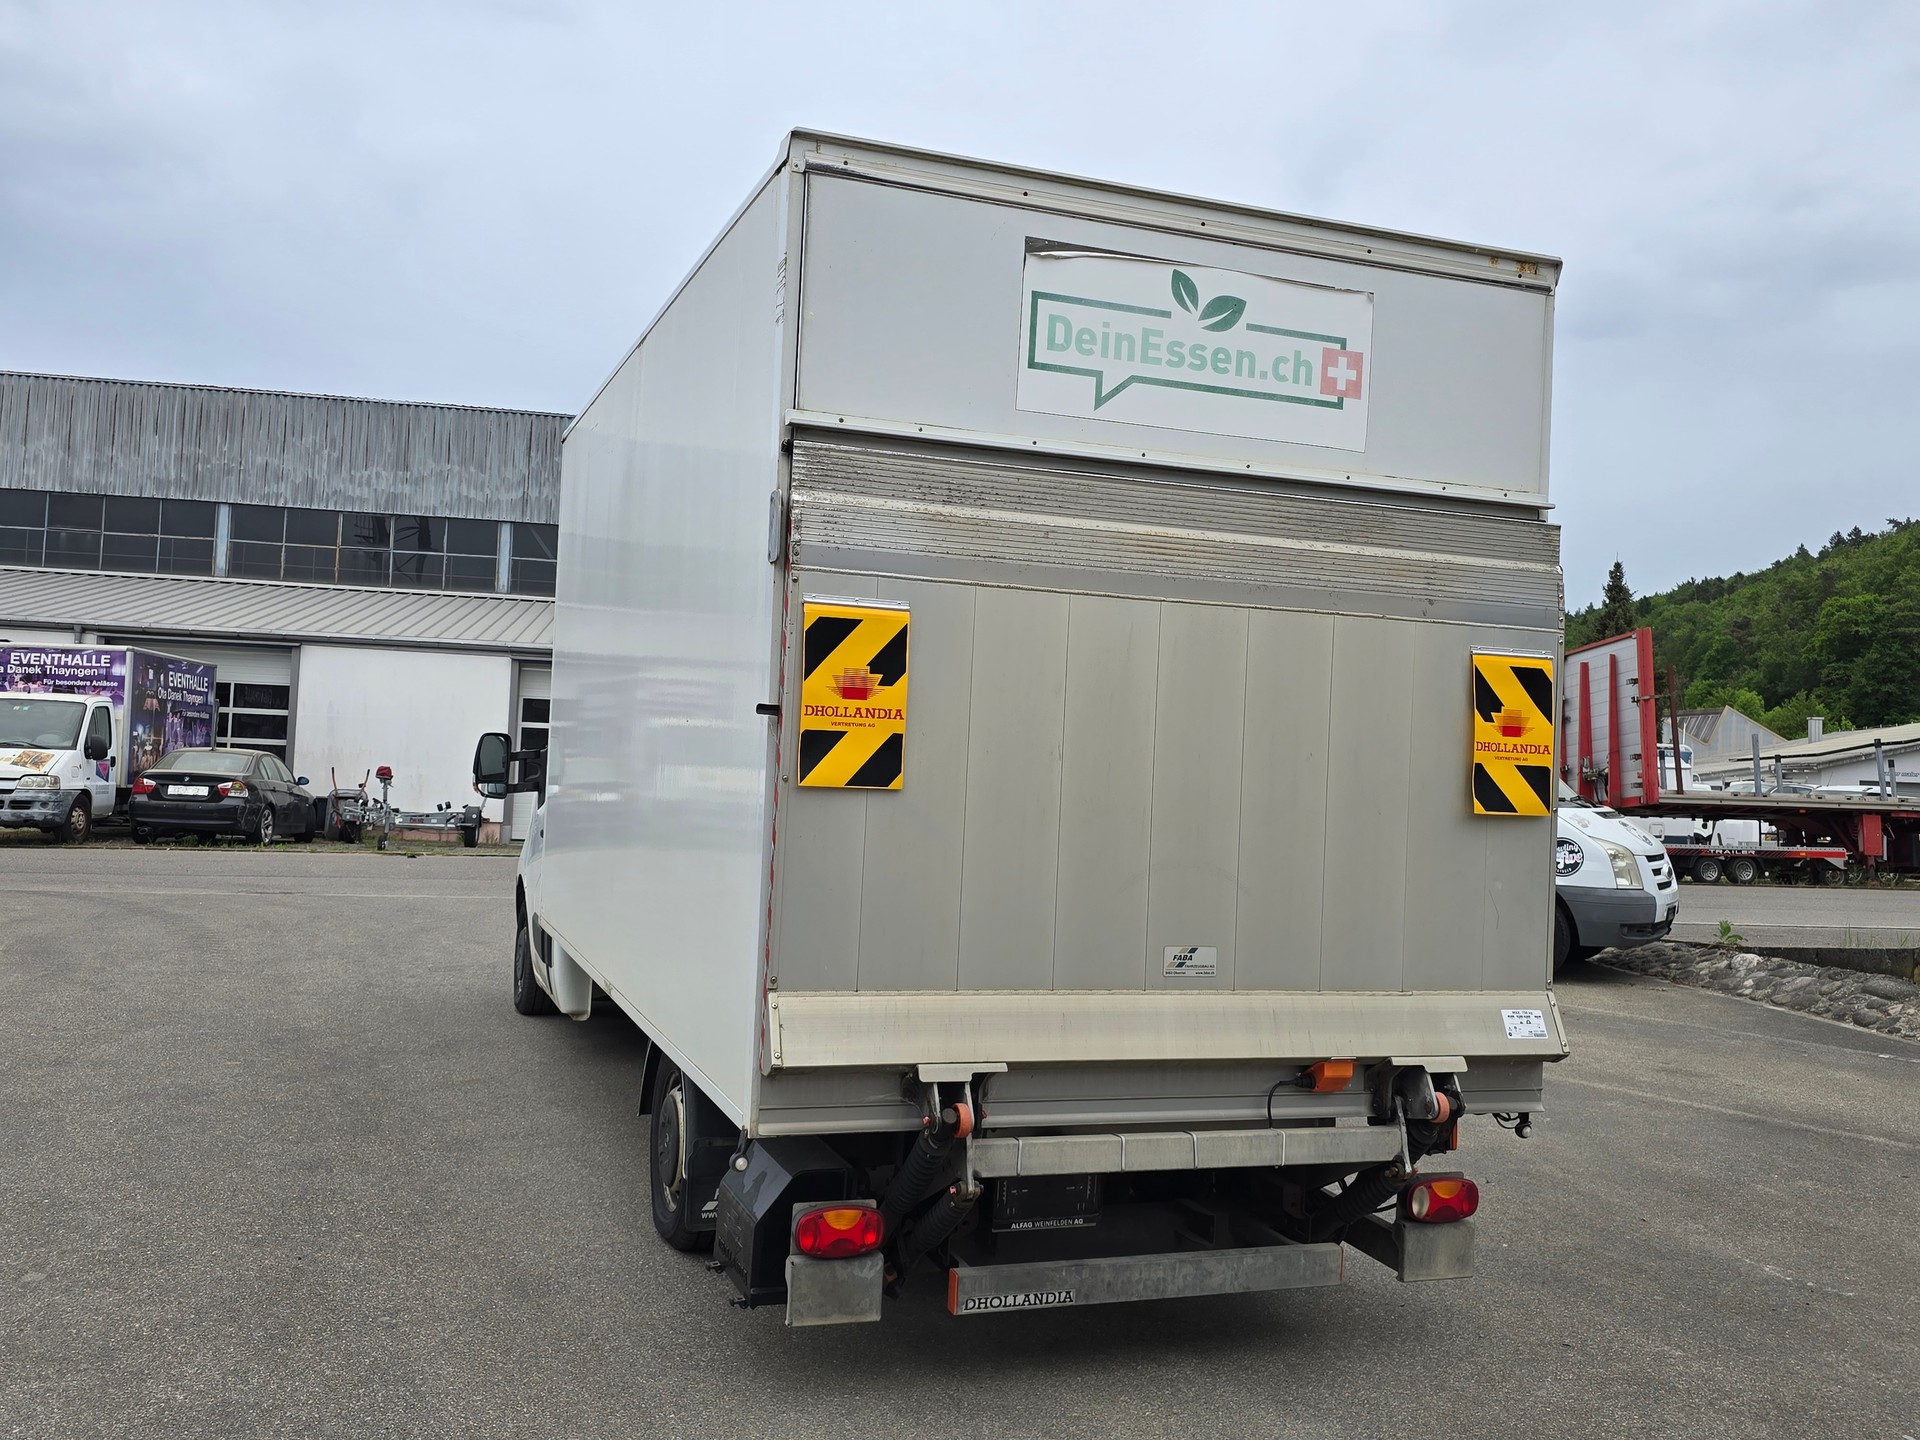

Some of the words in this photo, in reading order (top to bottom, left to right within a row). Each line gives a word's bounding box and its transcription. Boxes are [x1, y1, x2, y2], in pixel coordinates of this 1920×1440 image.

[1046, 313, 1313, 386] DeinEssen.ch
[10, 652, 111, 667] EVENTHALLE
[7, 664, 42, 674] Danek
[45, 665, 98, 678] Thayngen
[168, 671, 208, 692] EVENTHALLE
[168, 688, 182, 701] Danek
[804, 705, 905, 720] DHOLLANDIA
[1476, 741, 1551, 755] DHOLLANDIA
[1010, 1221, 1033, 1229] ALFAG
[1034, 1219, 1073, 1228] WEINFELDEN
[963, 1290, 1074, 1311] DHOLLANDIA
